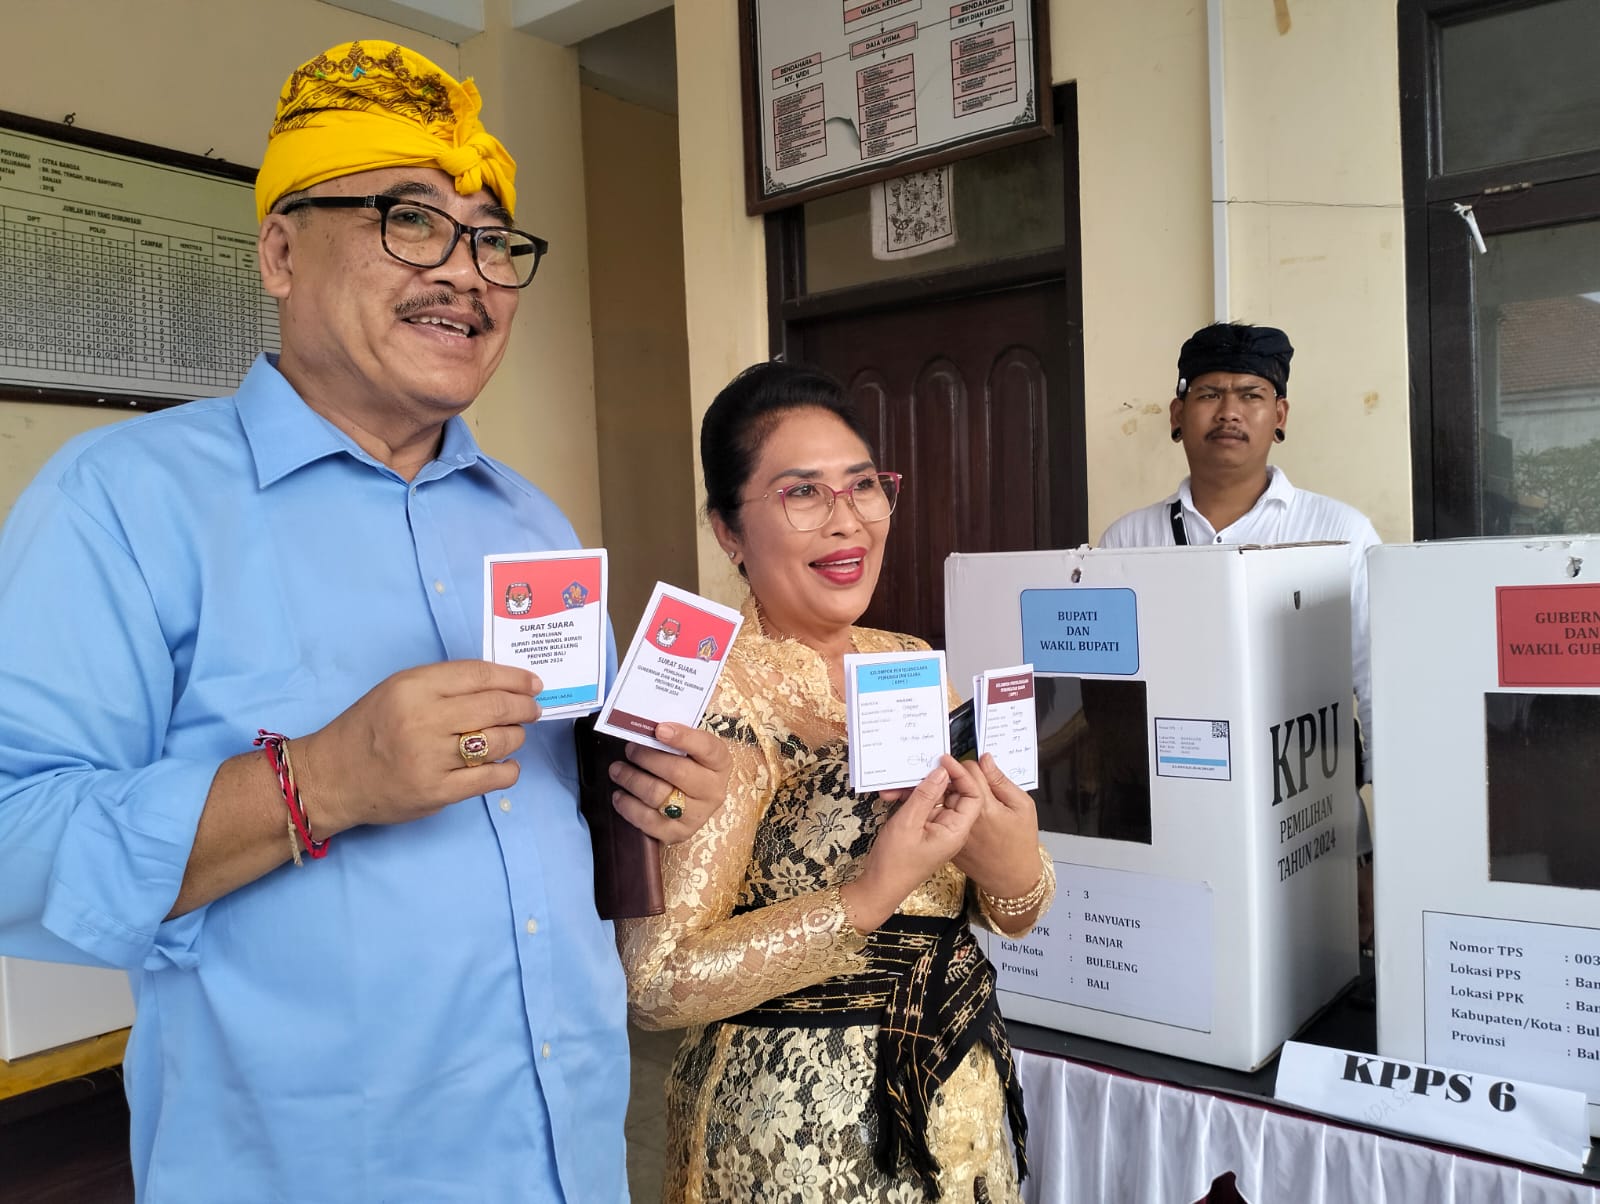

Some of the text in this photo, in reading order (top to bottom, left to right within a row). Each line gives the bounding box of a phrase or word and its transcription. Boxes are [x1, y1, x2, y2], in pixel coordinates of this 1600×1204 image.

[1058, 611, 1098, 622] BUPATI
[520, 620, 574, 632] SURAT SUARA
[1066, 626, 1090, 636] DAN
[1565, 627, 1599, 640] DAN
[514, 643, 578, 654] KABUPATEN BULELENG
[1040, 640, 1120, 652] WAKIL BUPATI
[1510, 643, 1564, 656] WAKIL
[528, 652, 552, 660] PROVINSI
[658, 656, 697, 676] SURAT SUARA
[1270, 702, 1339, 807] KPU
[1280, 794, 1334, 844] PEMILIHAN
[1278, 827, 1336, 882] TAHUN 2024
[1084, 890, 1090, 900] 3
[1084, 912, 1141, 929] BANYUATIS
[1085, 934, 1124, 949] BANJAR
[1001, 940, 1044, 958] Kab/Kota
[1086, 956, 1138, 974] BULELENG
[1450, 940, 1494, 955] Nomor
[1497, 945, 1524, 958] TPS
[1574, 953, 1600, 966] 003
[1002, 962, 1039, 977] Provinsi
[1087, 978, 1110, 991] BALI
[1450, 962, 1492, 978] Lokasi
[1496, 968, 1522, 981] PPS
[1450, 985, 1493, 1000] Lokasi
[1496, 991, 1524, 1004] PPK
[1451, 1008, 1562, 1032] Kabupaten/Kota
[1576, 1024, 1600, 1038] Bul
[1452, 1030, 1506, 1048] Provinsi
[1340, 1054, 1517, 1112] KPPS 6
